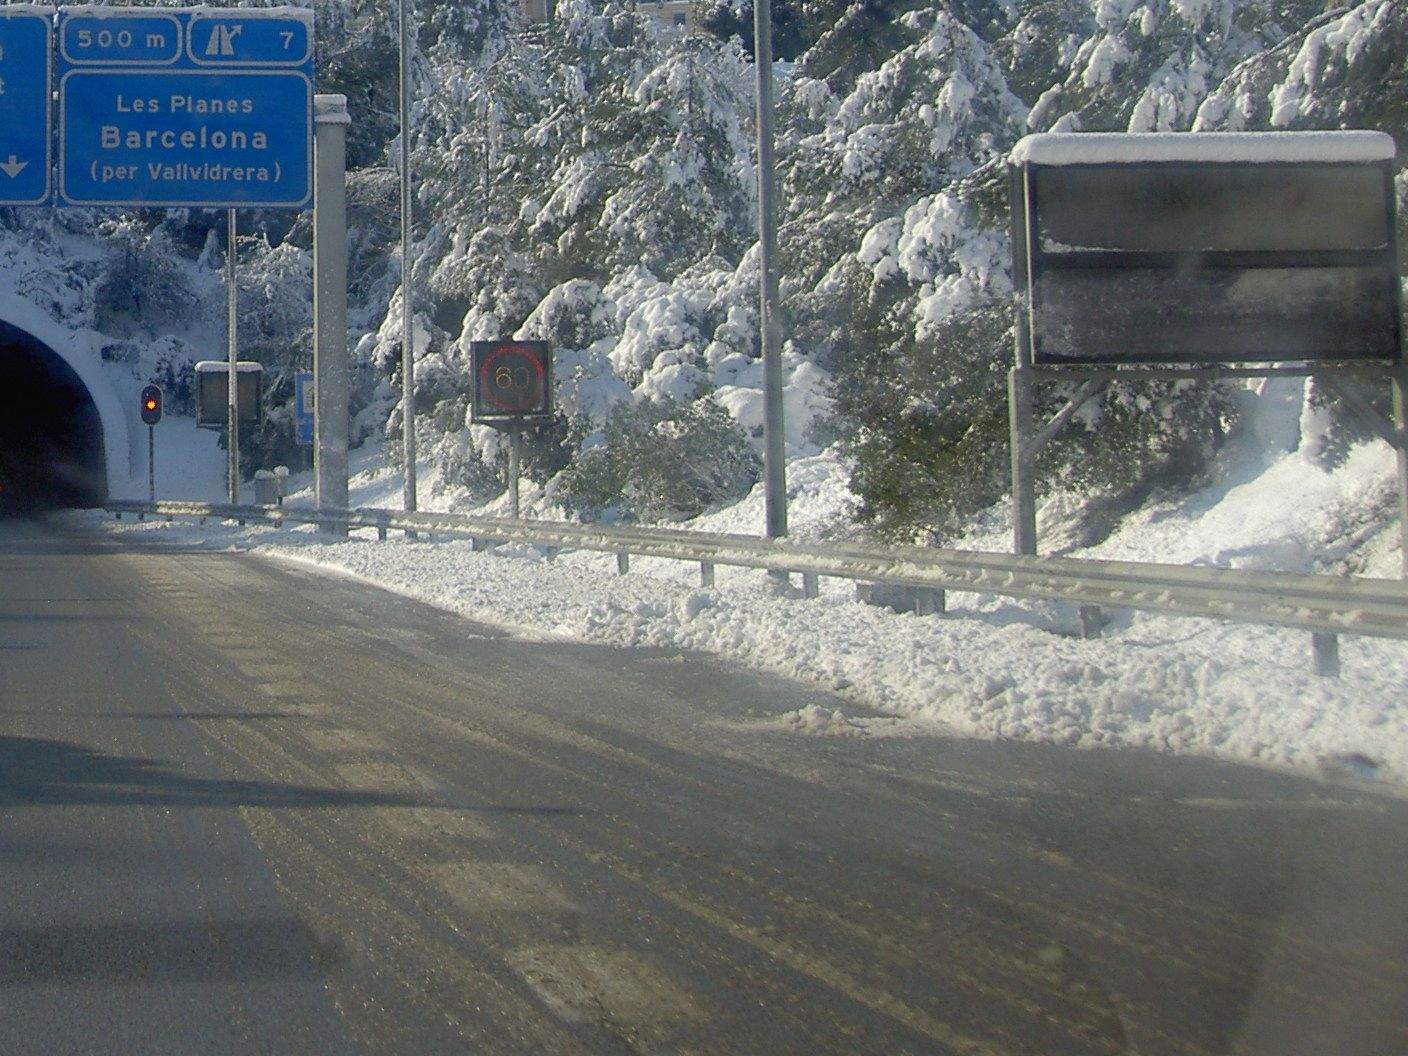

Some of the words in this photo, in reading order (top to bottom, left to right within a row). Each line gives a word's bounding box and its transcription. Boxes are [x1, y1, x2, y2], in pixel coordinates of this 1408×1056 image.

[78, 30, 132, 48] 500
[146, 34, 166, 48] m
[279, 31, 294, 50] 7
[117, 95, 159, 113] Les
[171, 95, 253, 113] Planes
[101, 125, 268, 149] Barcelona
[91, 160, 138, 183] (per
